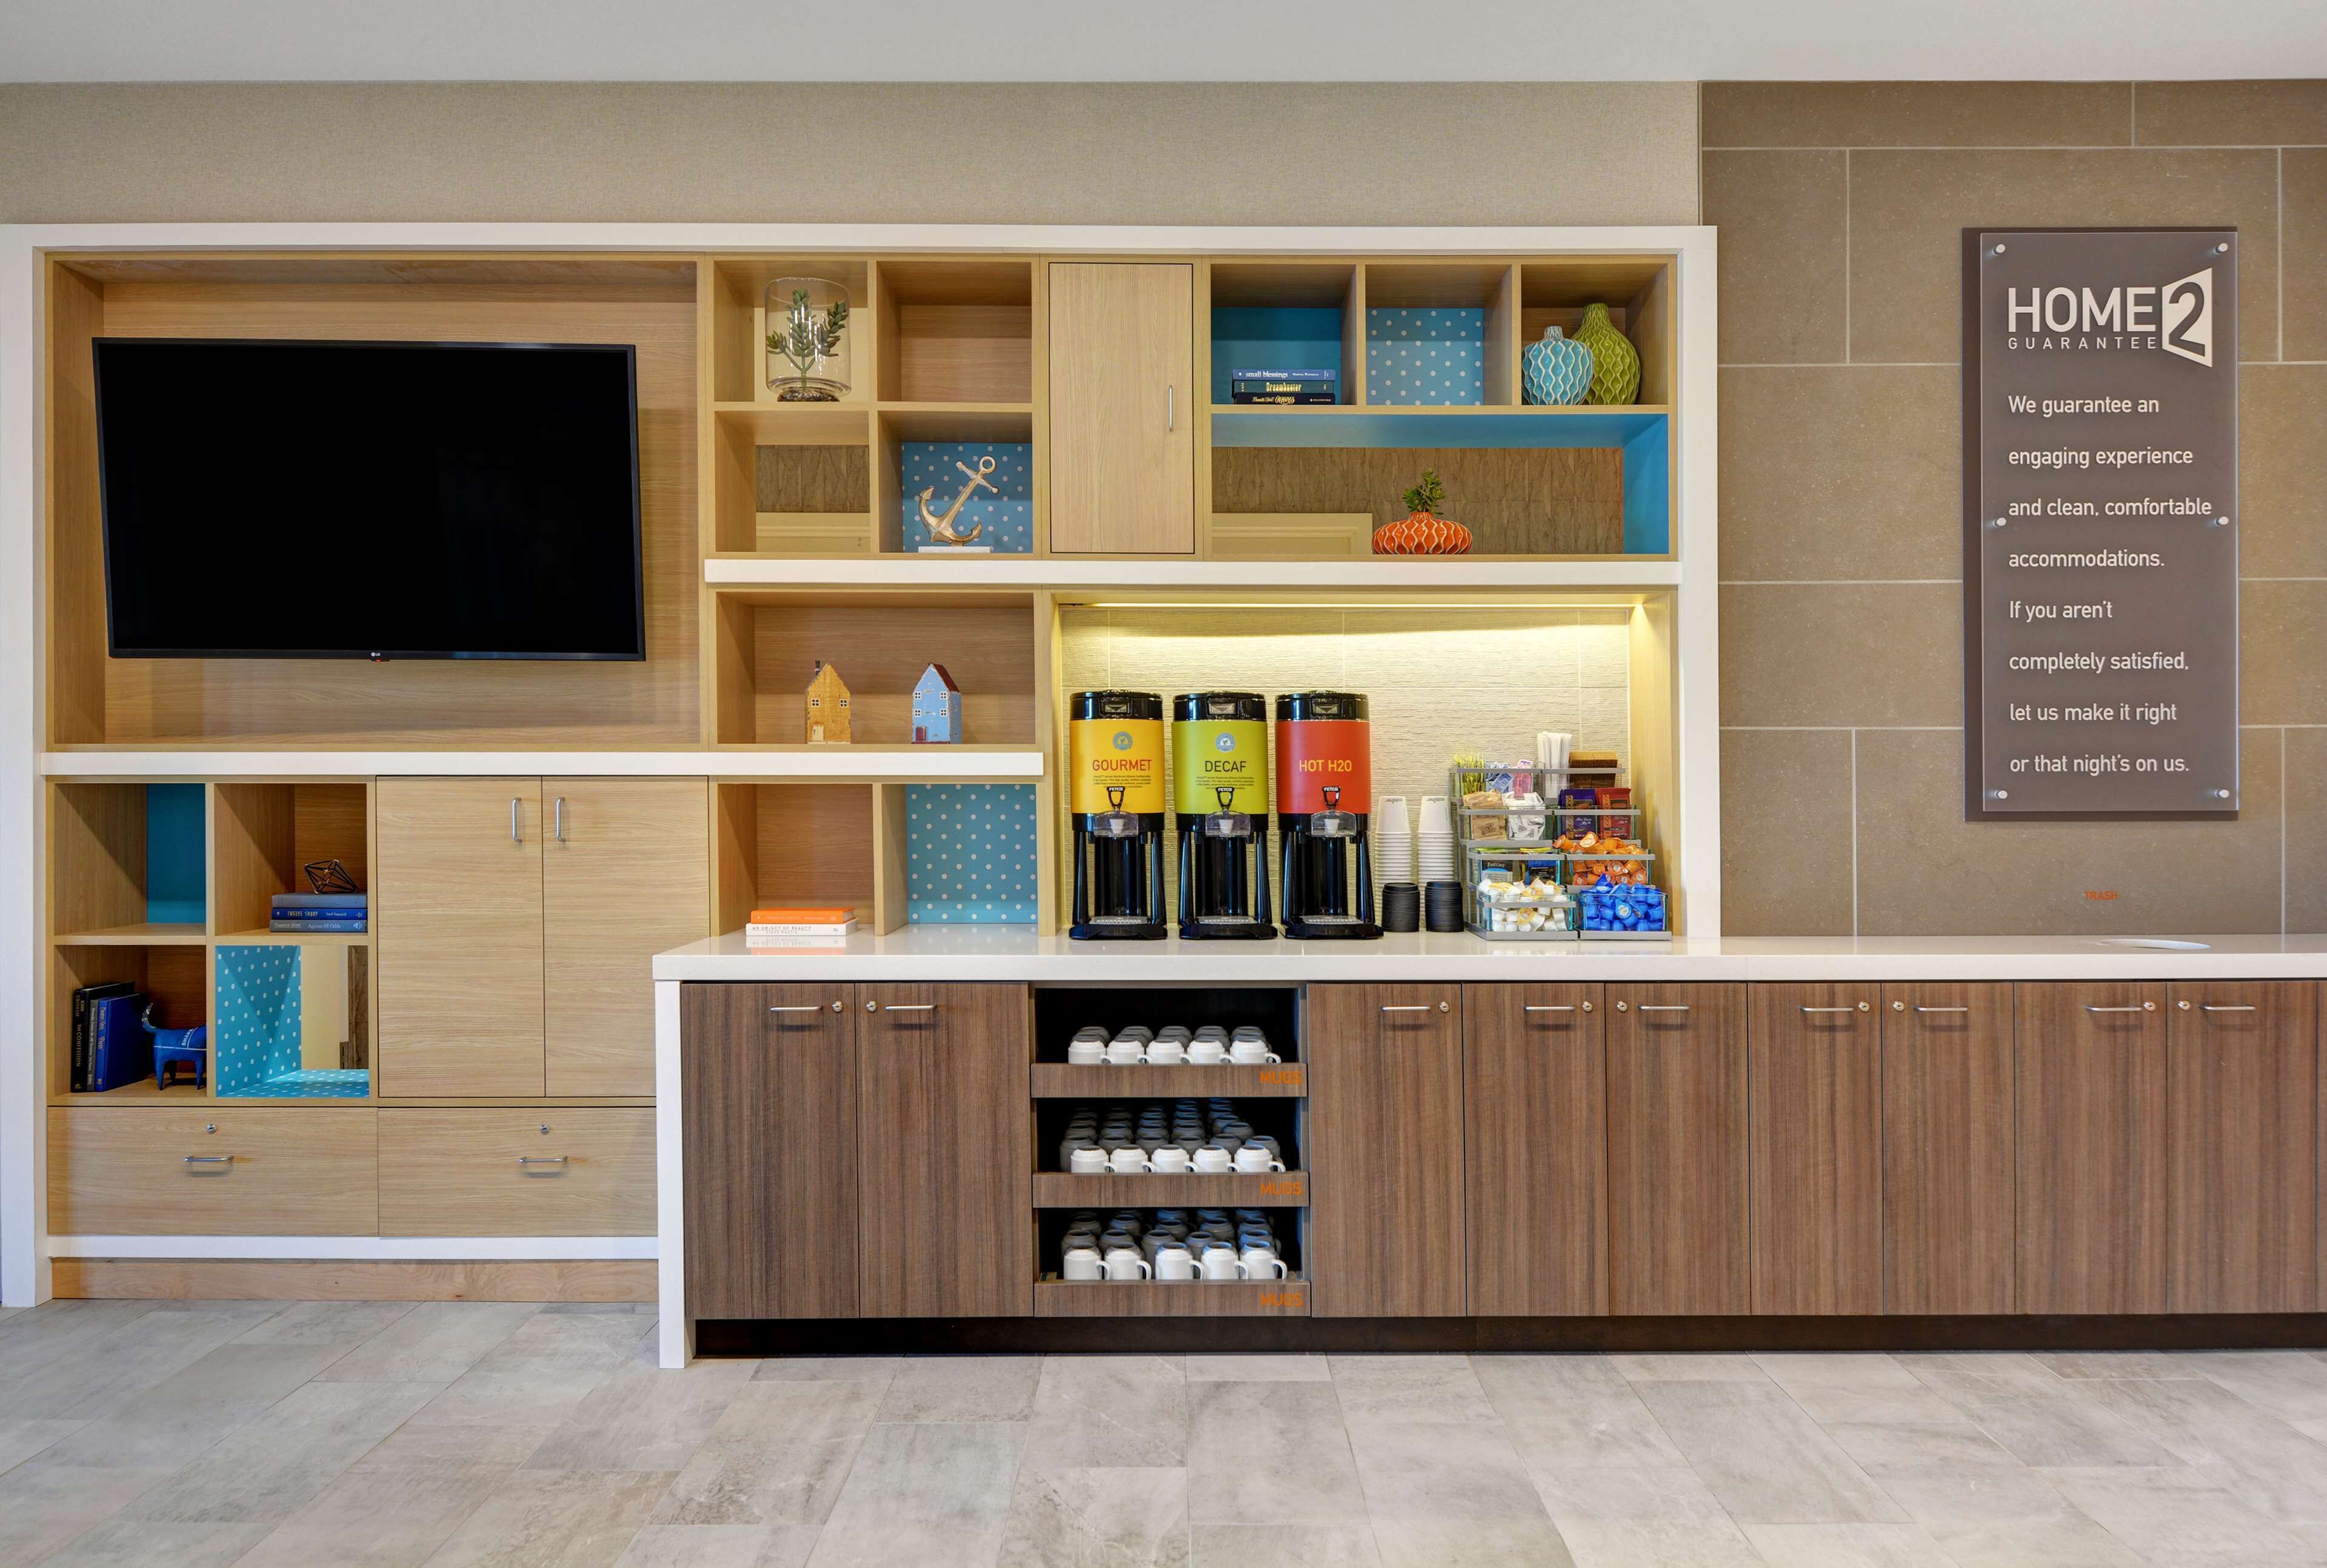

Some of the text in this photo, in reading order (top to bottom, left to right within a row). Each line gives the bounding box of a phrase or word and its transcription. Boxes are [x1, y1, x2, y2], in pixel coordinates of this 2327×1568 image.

[2008, 281, 2206, 358] HOME 2
[2008, 336, 2156, 350] GUARANTEE
[1266, 382, 1302, 392] Dreamhunter
[2008, 396, 2159, 418] We guarantee an
[2009, 447, 2193, 469] engaging experience
[2009, 498, 2212, 517] and clean, comfortable
[2009, 549, 2165, 567] accommodations.
[2010, 601, 2112, 622] If you aren't
[2009, 652, 2106, 673] completely
[2010, 703, 2177, 725] let us make it right
[1092, 759, 1152, 772] GOURMET
[1204, 761, 1247, 773] DECAF
[1299, 759, 1324, 772] HOT
[2010, 755, 2189, 776] or that night's on us.
[2085, 890, 2119, 900] TRASH
[1260, 1070, 1303, 1085] MUGS
[1260, 1181, 1303, 1196] MUGS
[1260, 1293, 1303, 1307] MUGS
